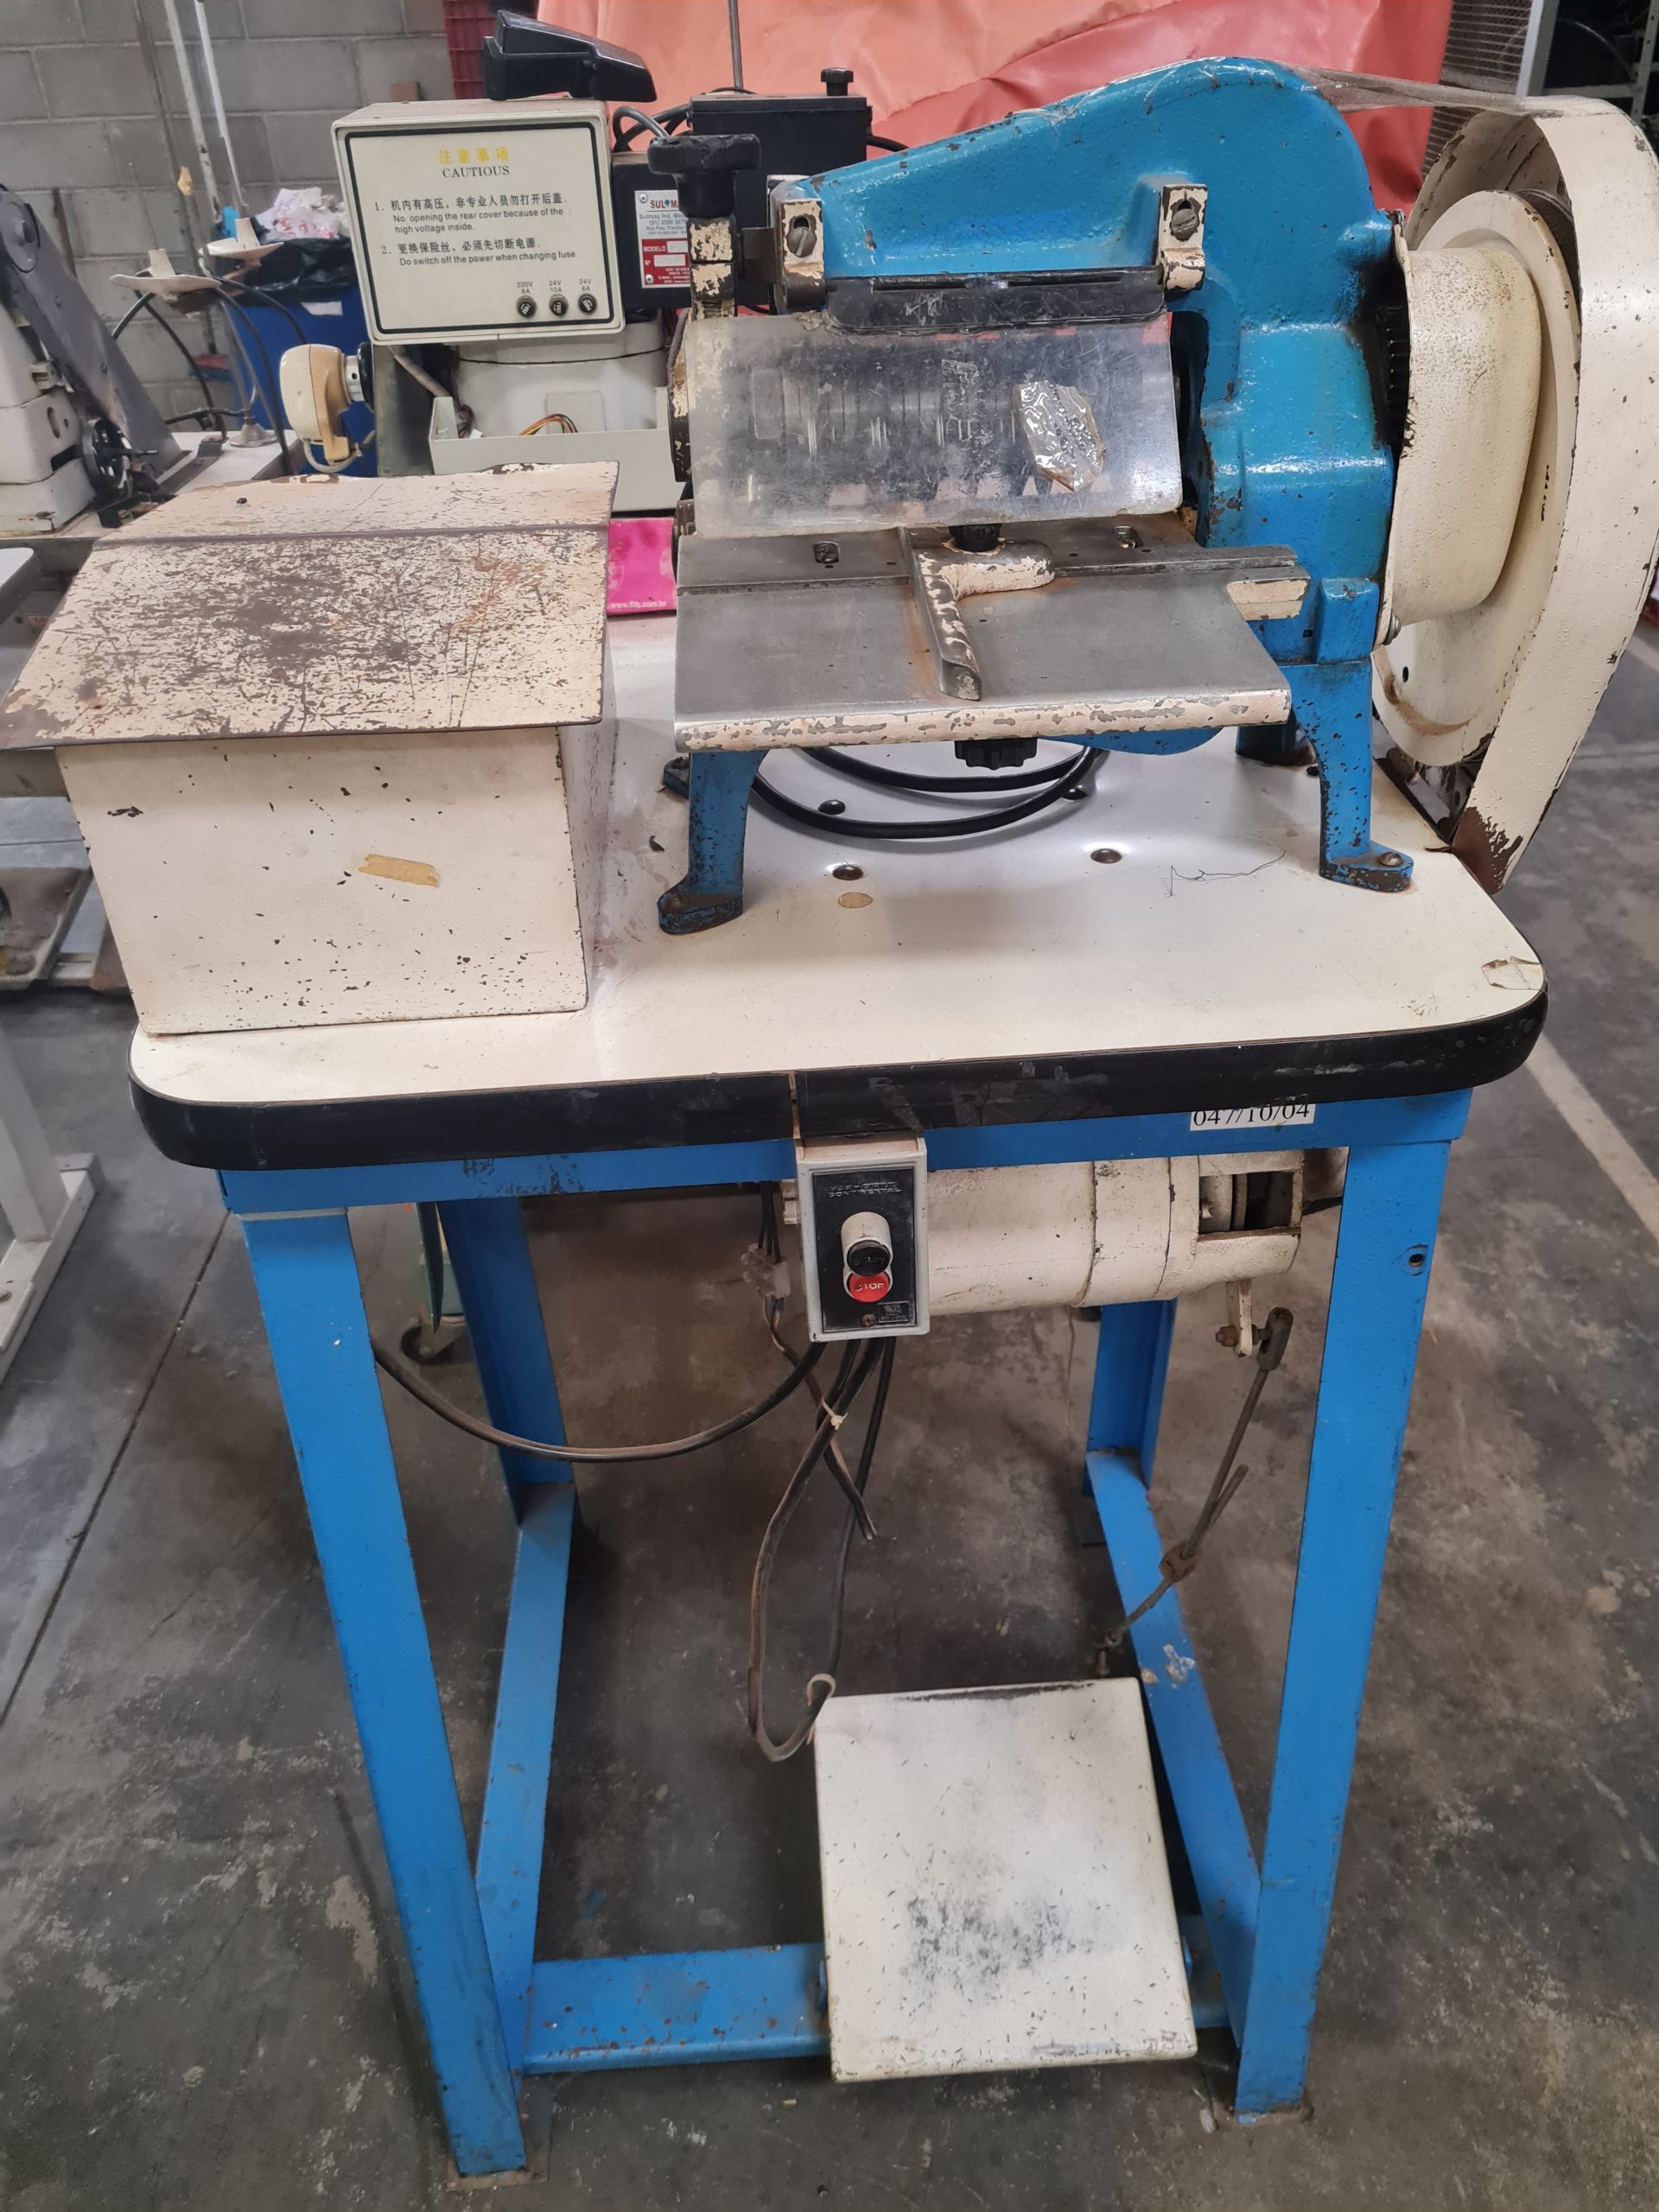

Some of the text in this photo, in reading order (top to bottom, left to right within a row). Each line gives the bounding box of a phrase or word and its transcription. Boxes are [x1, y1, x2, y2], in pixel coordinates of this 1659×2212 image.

[442, 166, 510, 178] CAUTIOUS
[393, 214, 405, 223] No
[410, 213, 443, 223] opening
[504, 208, 538, 218] because
[540, 207, 549, 216] of
[395, 223, 475, 235] high voltage inside.
[413, 257, 440, 265] switch
[441, 256, 452, 264] off
[468, 255, 494, 264] power
[518, 251, 557, 261] changing
[855, 1282, 885, 1293] STOP
